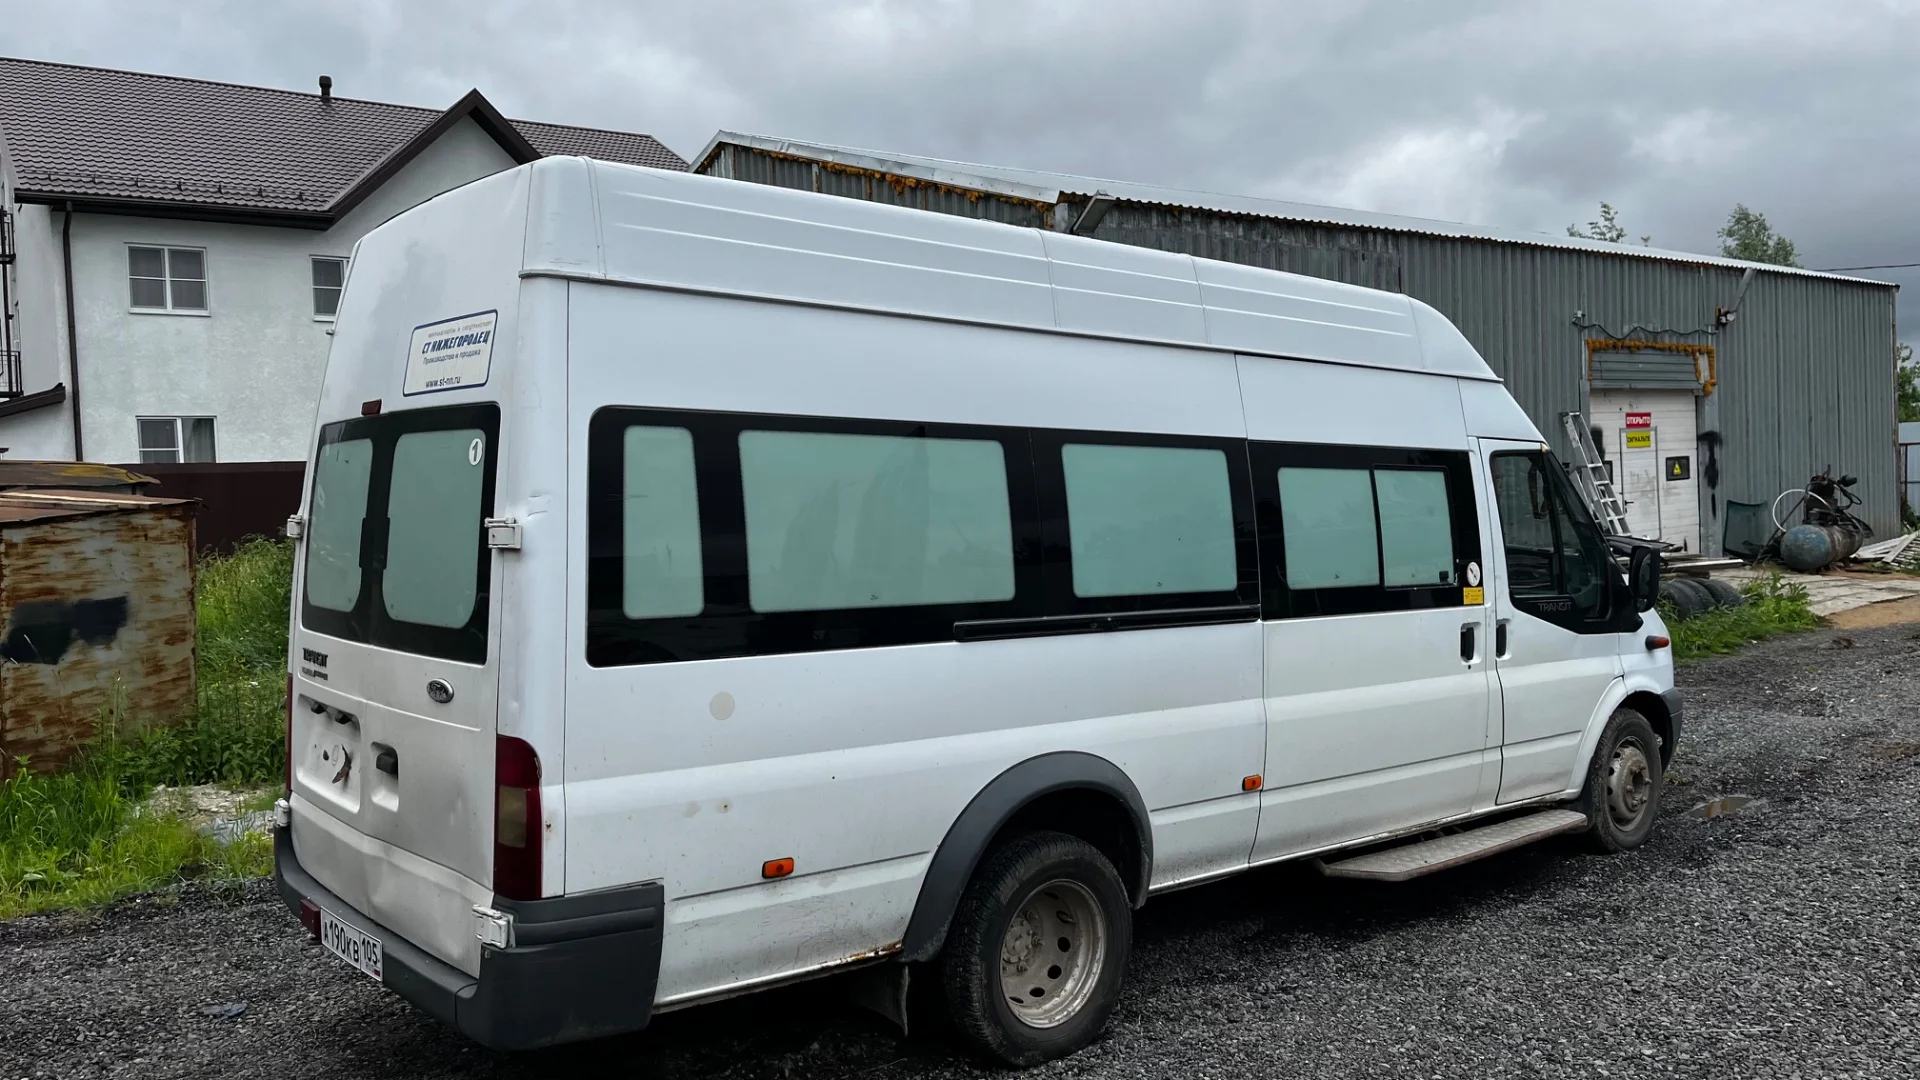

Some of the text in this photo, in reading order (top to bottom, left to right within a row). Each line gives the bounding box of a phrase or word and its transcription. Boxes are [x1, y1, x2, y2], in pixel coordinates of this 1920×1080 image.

[422, 341, 432, 355] СТ
[430, 330, 491, 353] НИЖЕГОРОДЕЦ
[423, 353, 455, 366] Производство
[459, 349, 481, 360] продажа
[425, 376, 461, 388] www.st-nn.ru
[1626, 416, 1651, 425] ОТКРЫТО
[472, 441, 478, 462] 1
[1537, 602, 1572, 612] TRANSIT
[361, 937, 378, 965] 105
